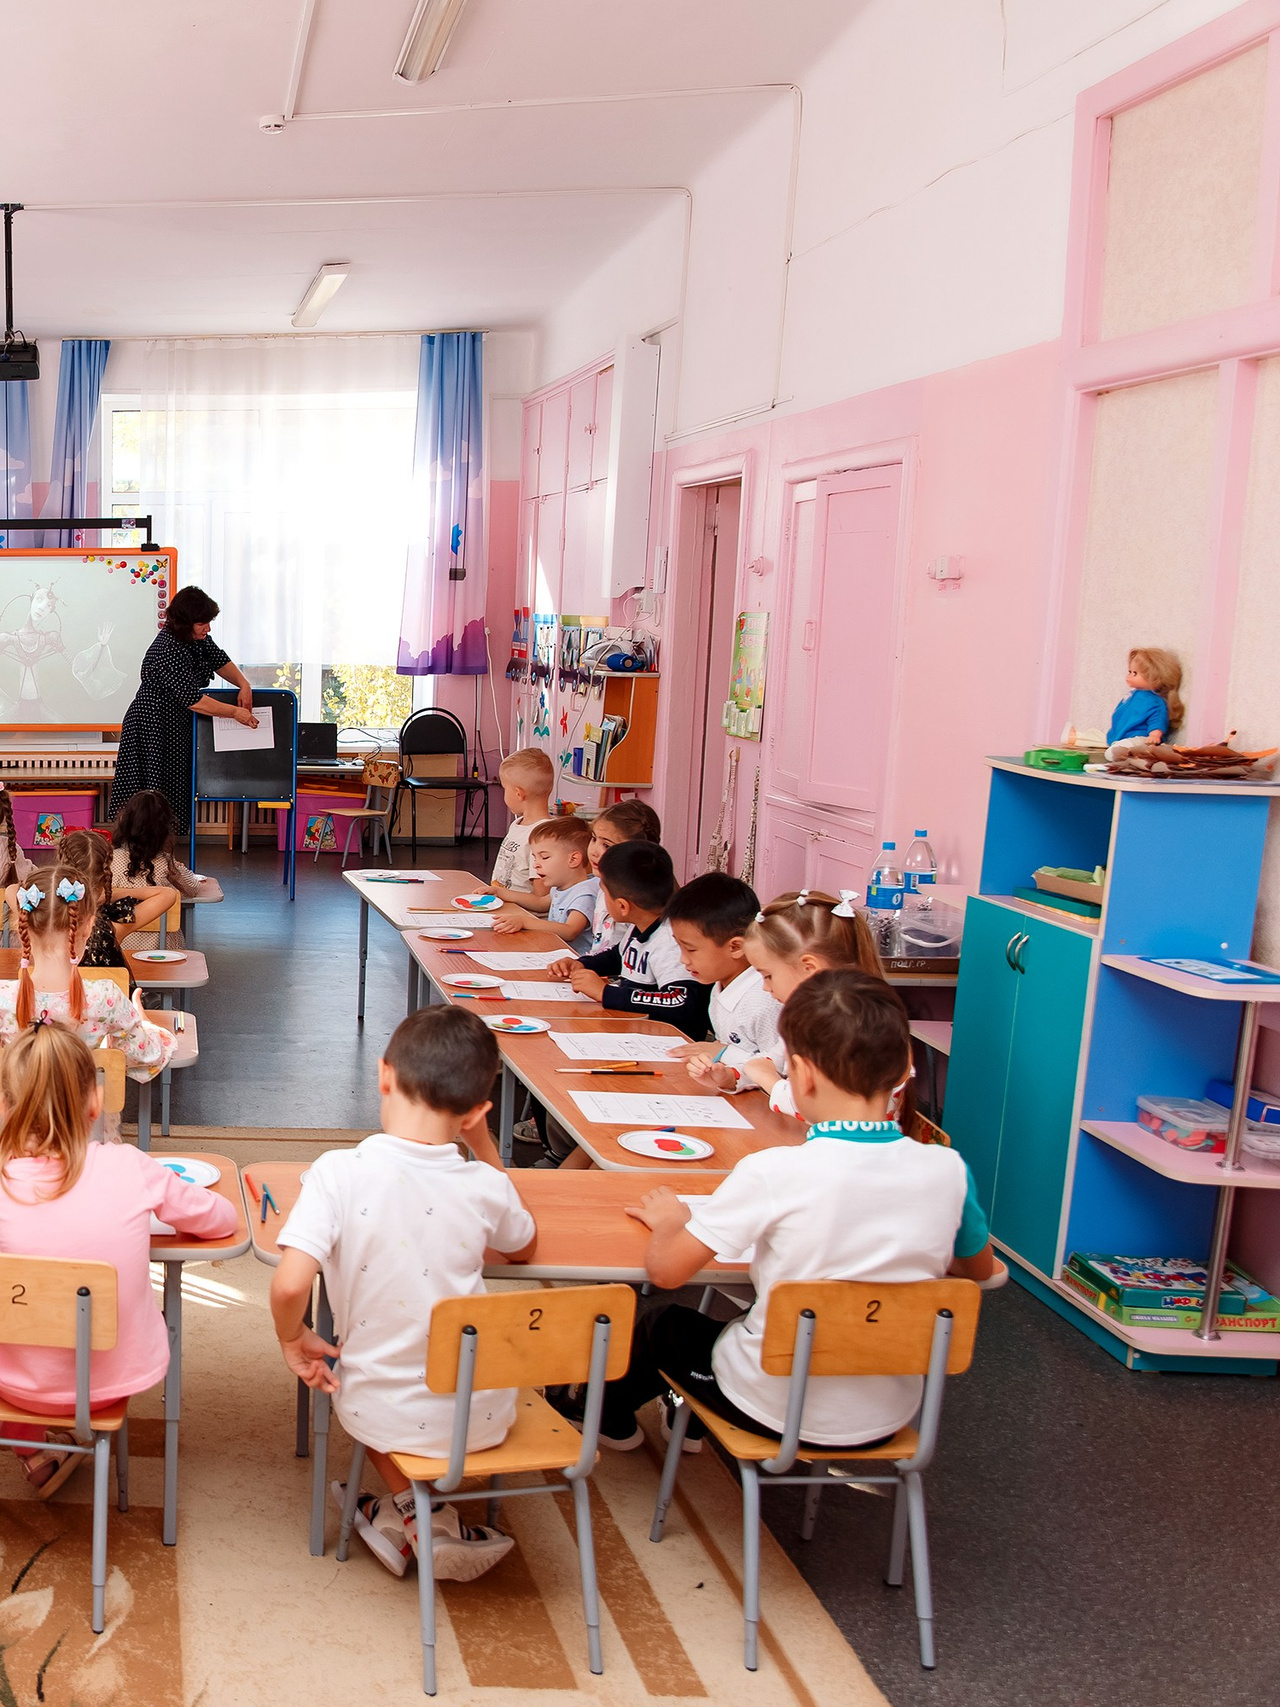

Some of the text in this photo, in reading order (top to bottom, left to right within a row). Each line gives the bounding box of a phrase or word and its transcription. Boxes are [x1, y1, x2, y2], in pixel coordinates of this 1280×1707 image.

[12, 1284, 28, 1306] 2
[529, 1308, 543, 1331] 2
[865, 1300, 881, 1323] 2
[1214, 1317, 1277, 1329] РАНСПОРТ
